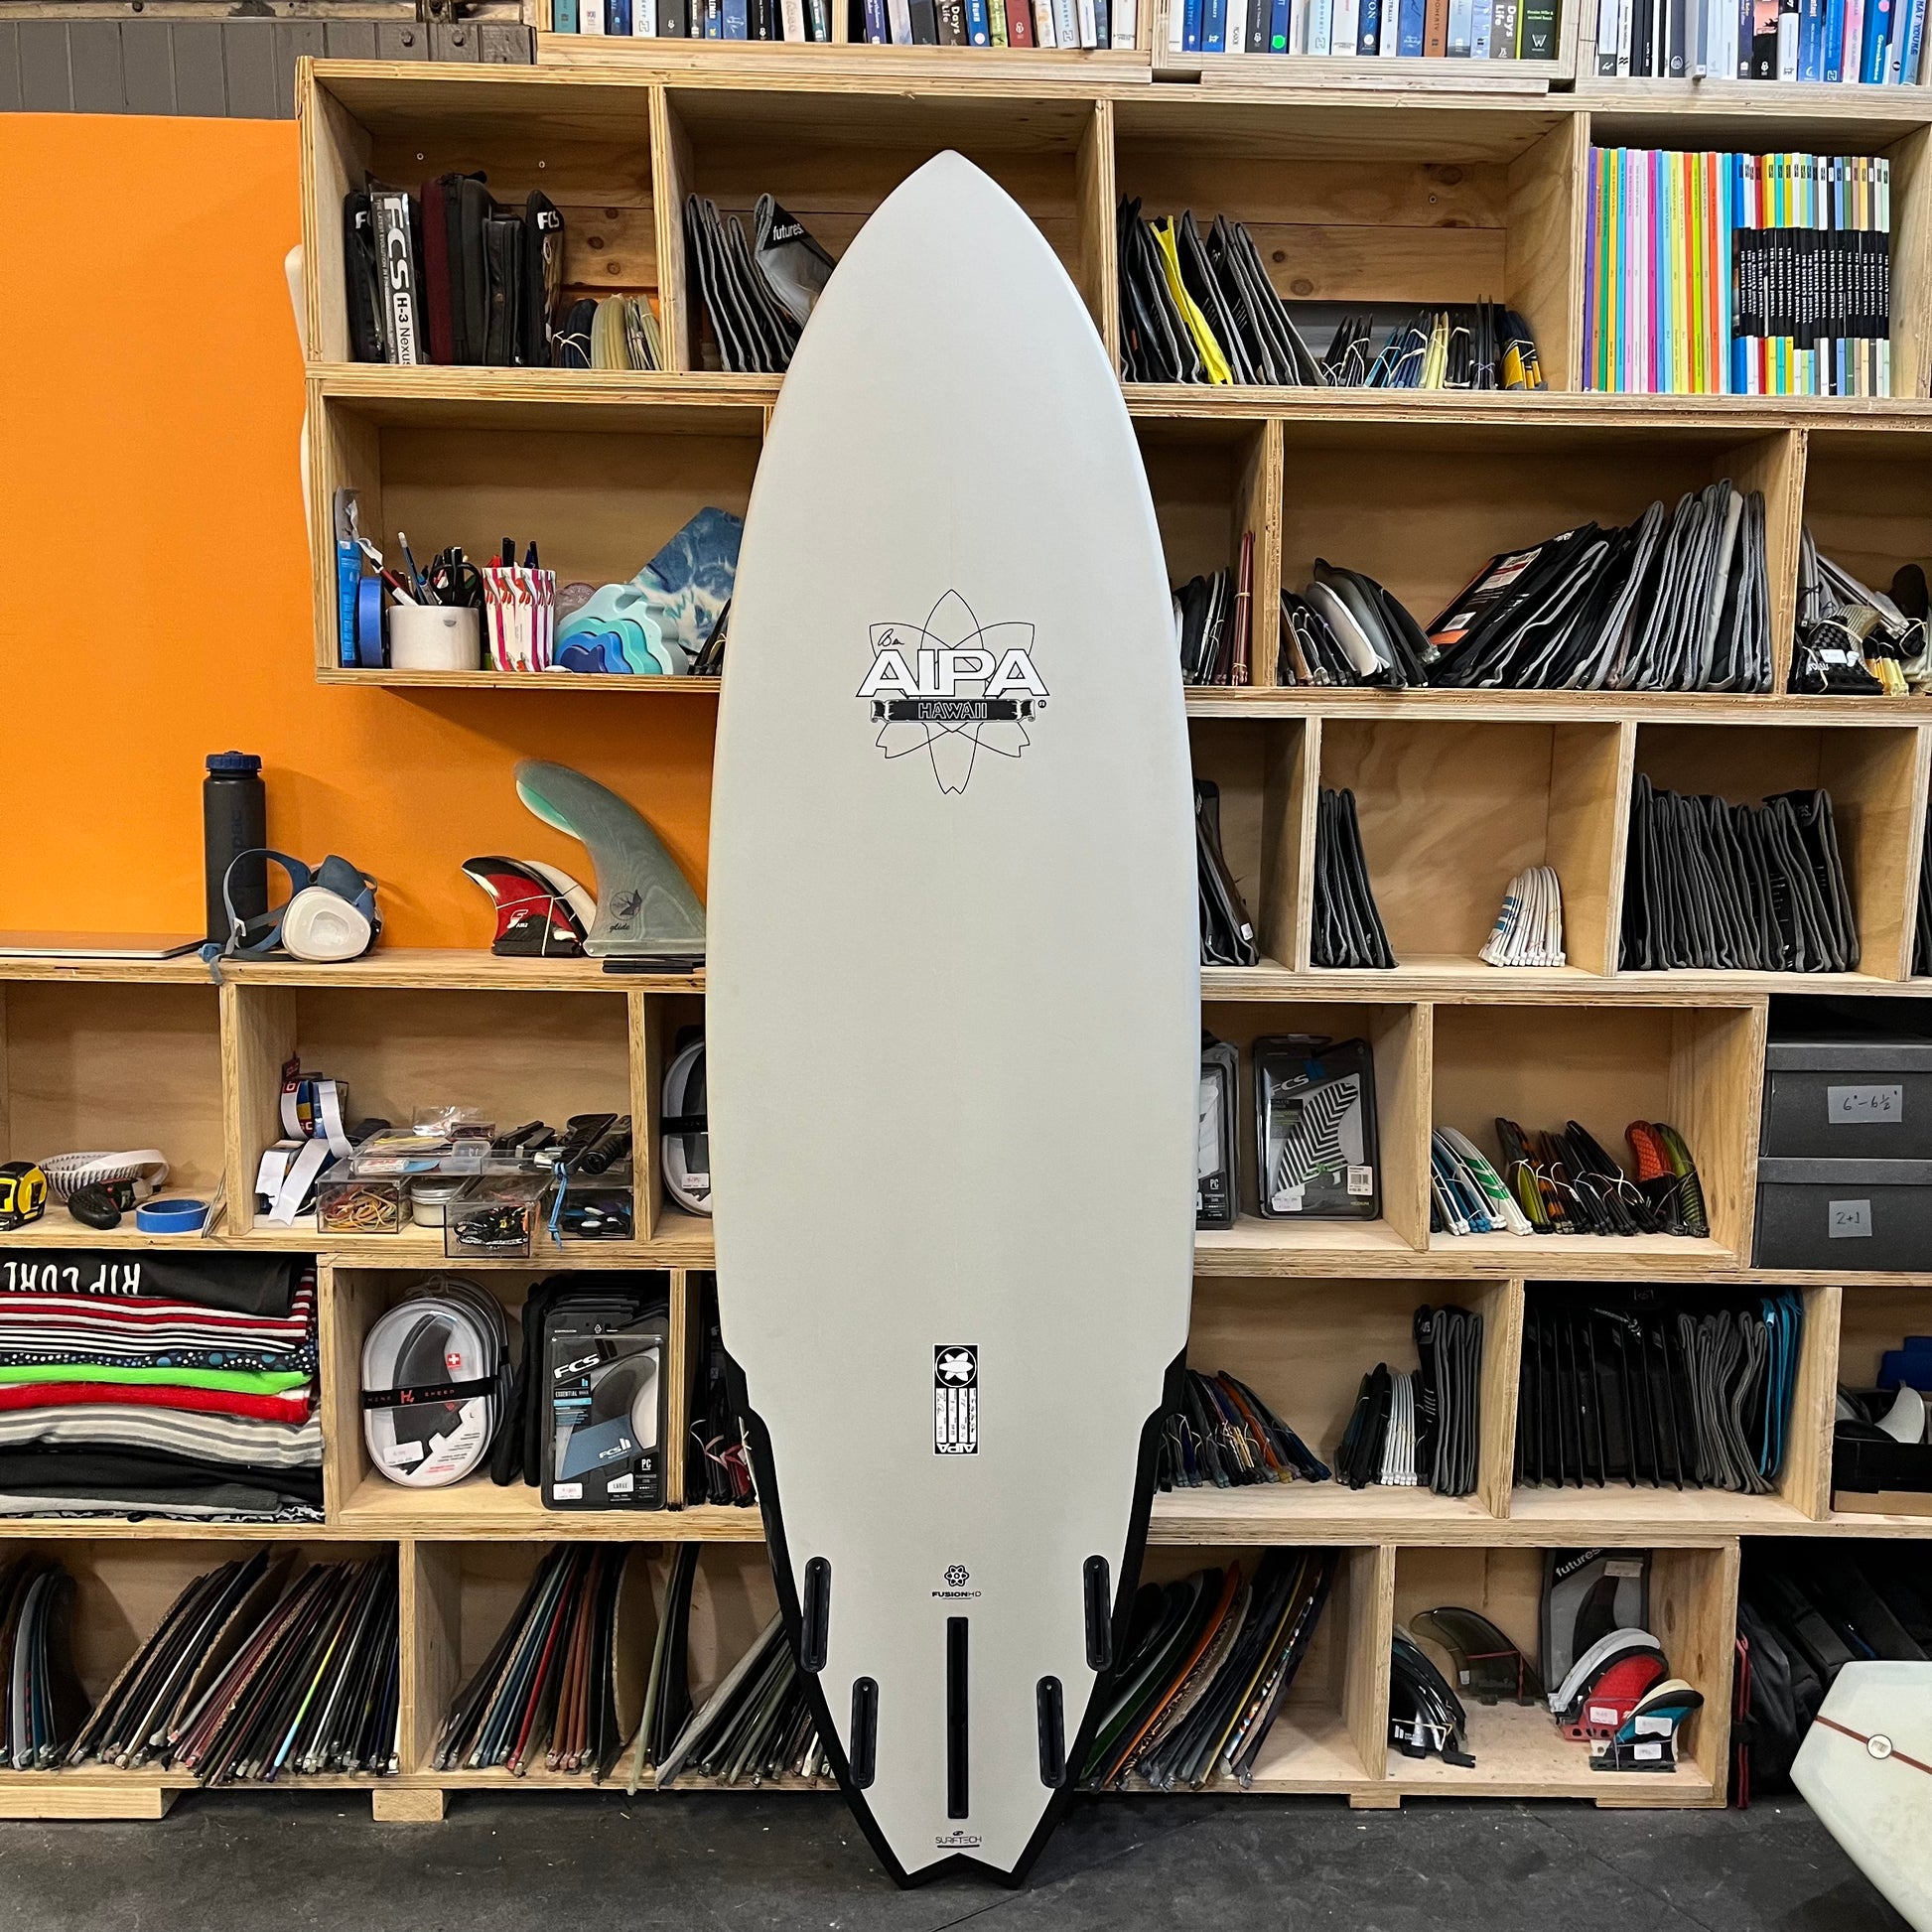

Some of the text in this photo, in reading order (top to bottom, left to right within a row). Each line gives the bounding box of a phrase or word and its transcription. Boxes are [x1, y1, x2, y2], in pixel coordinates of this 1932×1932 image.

[951, 6, 960, 35] Days
[1494, 4, 1505, 26] Life
[1506, 5, 1517, 38] Days
[384, 198, 410, 289] FCS
[397, 297, 411, 365] H-3 Nexus
[856, 648, 1050, 700] AIPA
[917, 701, 988, 720] HAWAII
[609, 922, 630, 933] glide
[1836, 1211, 1861, 1225] 2+1
[89, 1262, 141, 1296] RIP
[553, 1353, 601, 1379] FCS
[599, 1446, 622, 1459] FCS
[936, 1443, 977, 1453] AIPA
[641, 1458, 651, 1468] PC
[934, 1836, 982, 1845] SURFTECH
